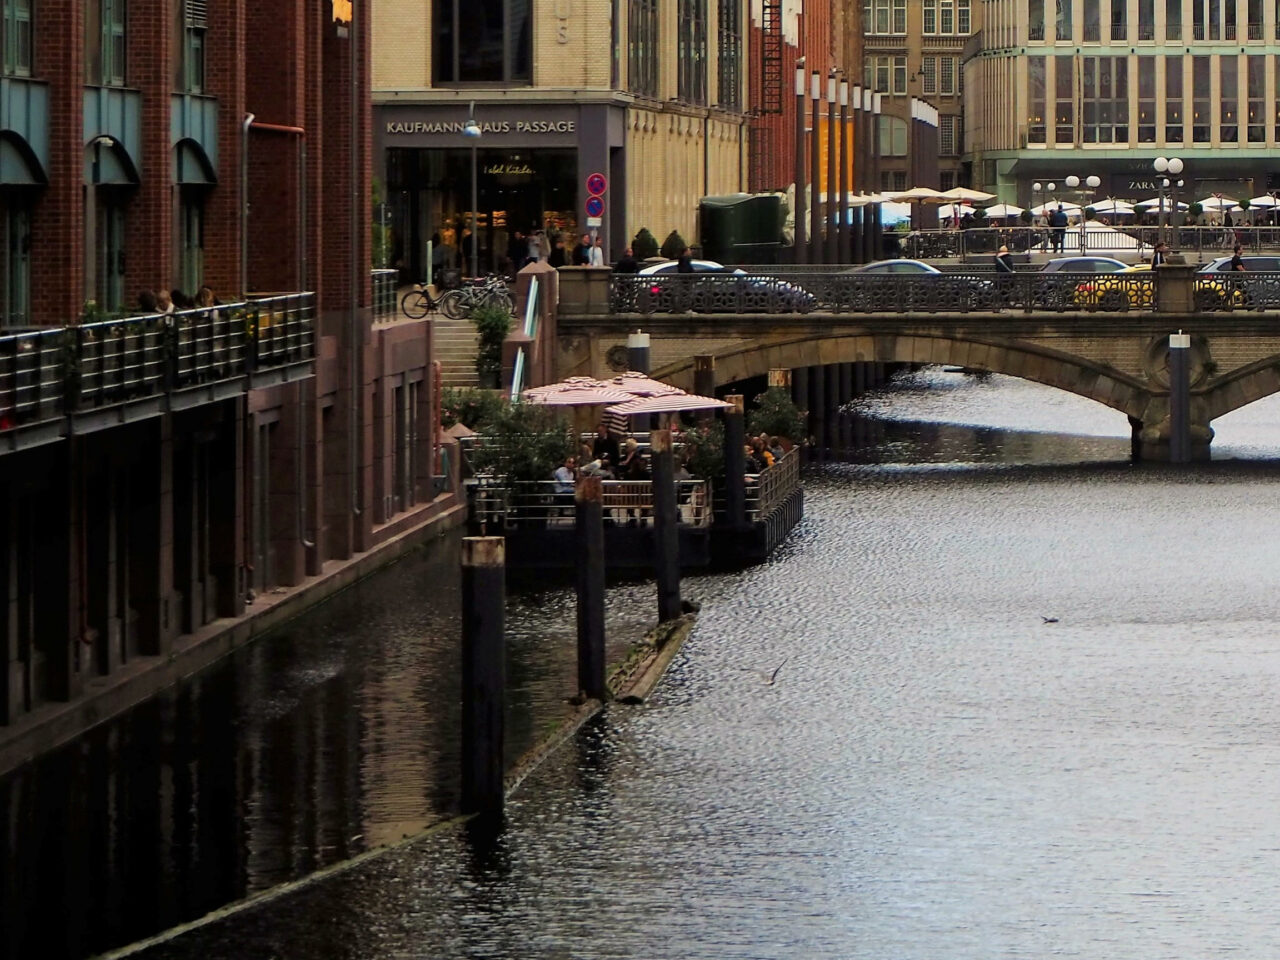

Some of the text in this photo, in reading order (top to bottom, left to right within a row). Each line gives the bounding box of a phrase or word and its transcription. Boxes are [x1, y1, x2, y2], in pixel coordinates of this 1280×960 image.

[386, 121, 575, 133] KAUFMANNAUS PASSAGE
[1128, 181, 1155, 190] ZARA
